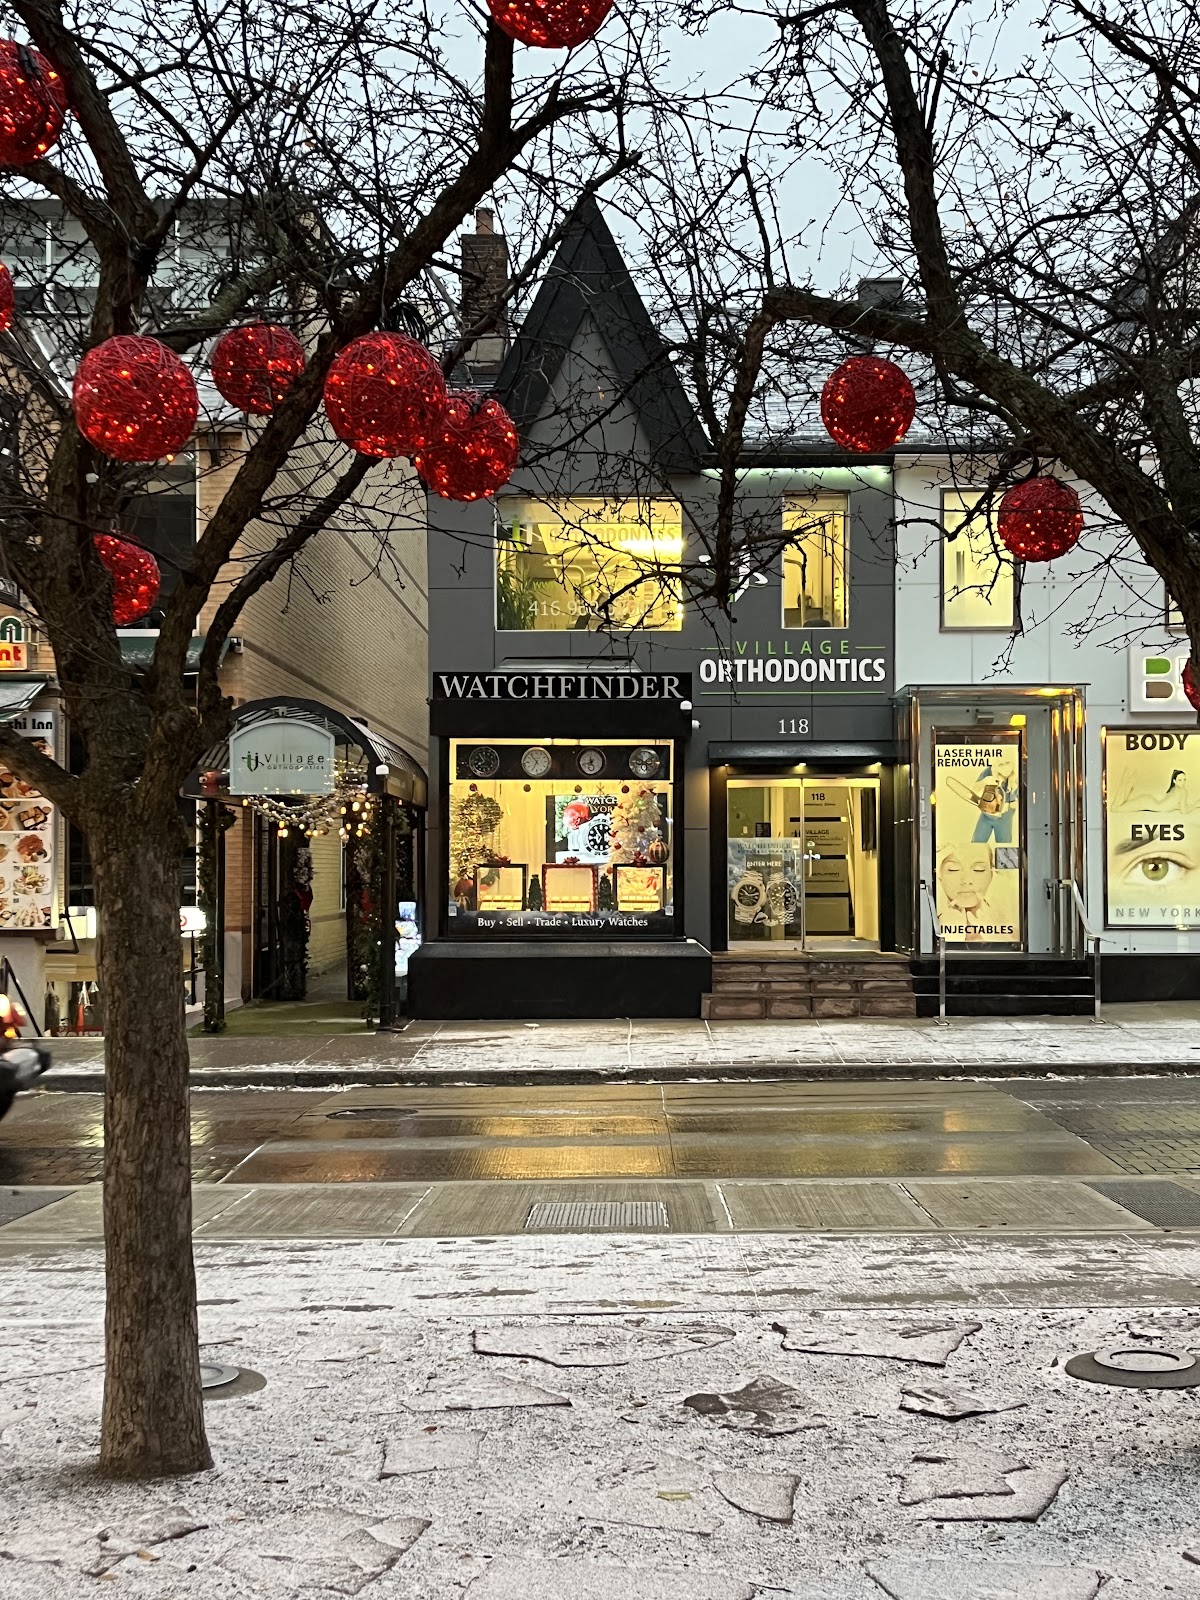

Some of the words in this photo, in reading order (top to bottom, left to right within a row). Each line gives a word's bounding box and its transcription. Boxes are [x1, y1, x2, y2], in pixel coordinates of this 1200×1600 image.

[736, 640, 849, 655] VILLAGE
[700, 658, 886, 683] ORTHODONTICS
[440, 675, 684, 699] WATCHFINDER
[32, 719, 53, 730] Inn
[778, 718, 809, 734] 118
[1125, 734, 1189, 751] BODY
[937, 749, 972, 758] LASER
[975, 749, 1003, 758] HAIR
[264, 754, 325, 765] Village
[937, 758, 993, 767] REMOVAL
[811, 792, 826, 801] 118
[1131, 824, 1185, 841] EYES
[1115, 908, 1150, 918] NEW
[1160, 908, 1200, 918] YORK
[477, 918, 496, 928] Buy
[506, 917, 524, 927] Sell
[534, 917, 562, 927] Trade
[571, 917, 606, 929] Luxury
[608, 917, 648, 927] Watches
[940, 925, 1014, 934] INJECTABLES
